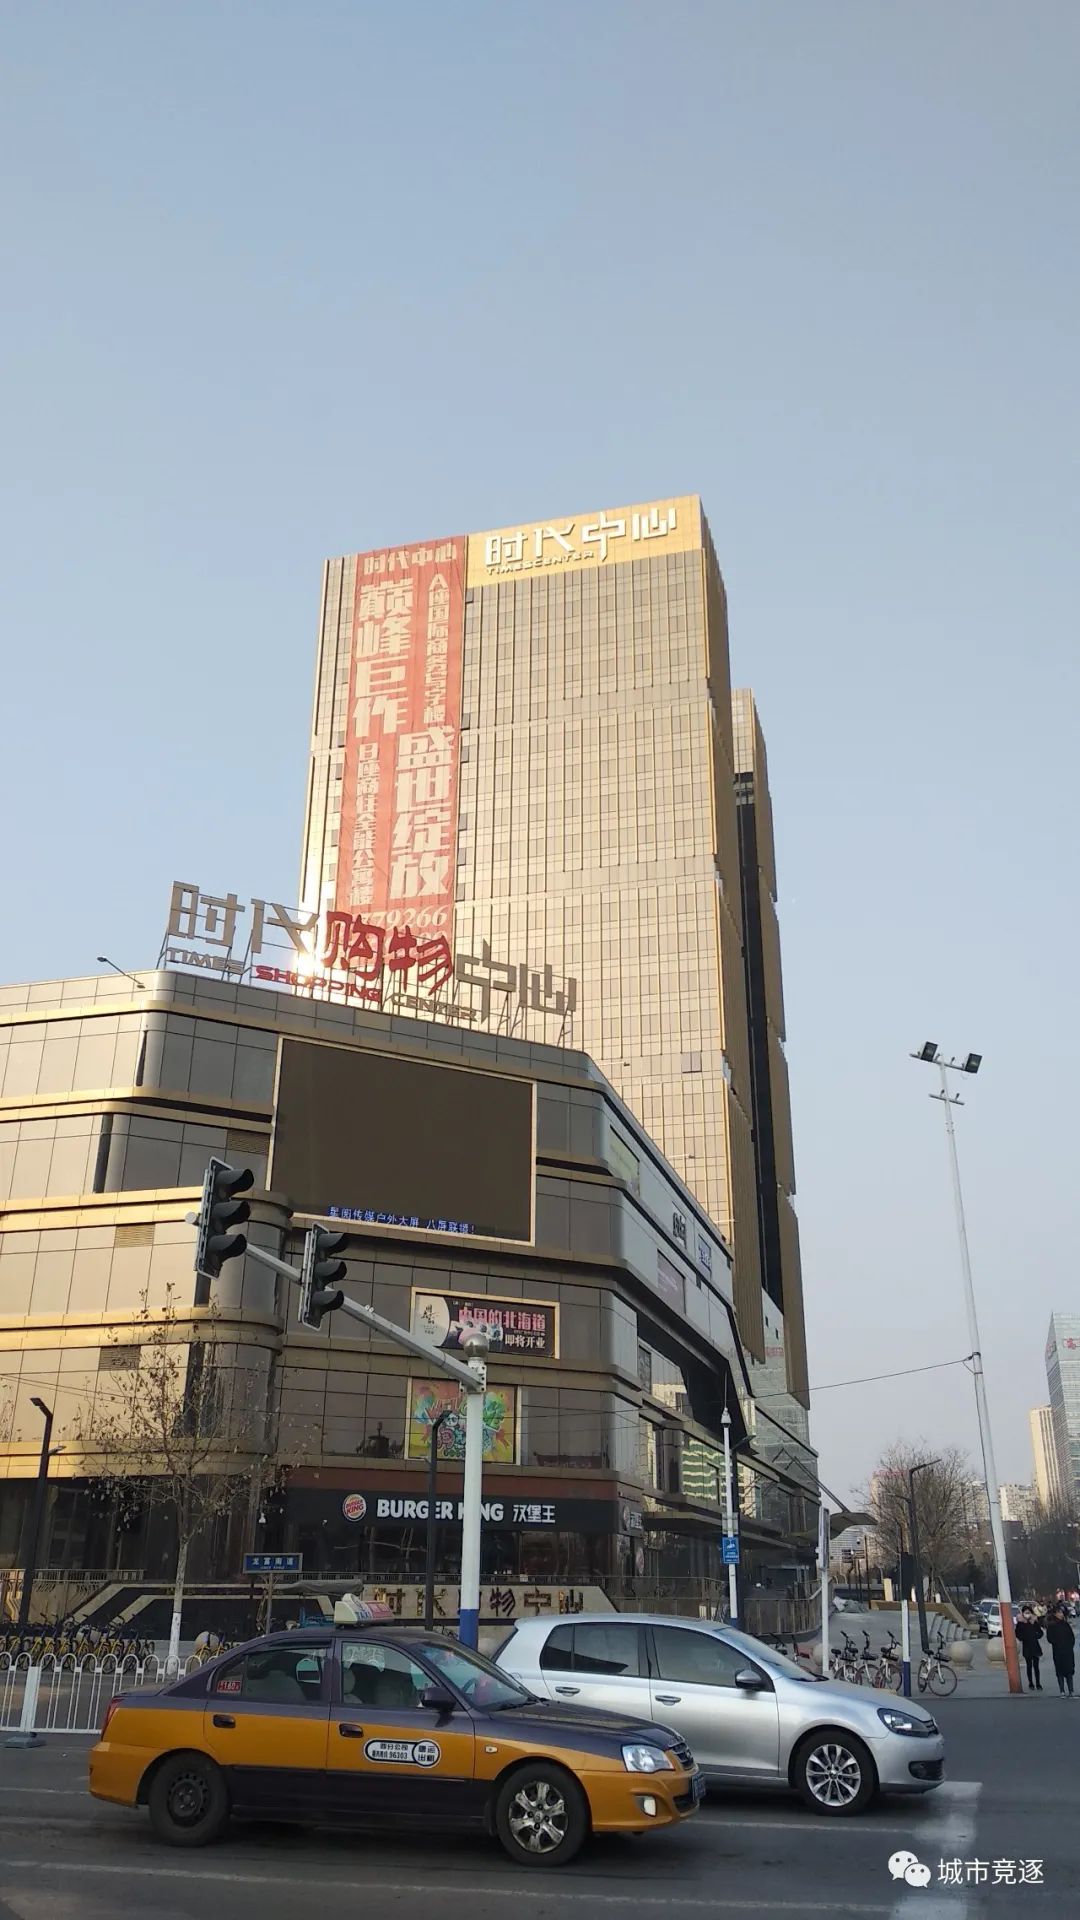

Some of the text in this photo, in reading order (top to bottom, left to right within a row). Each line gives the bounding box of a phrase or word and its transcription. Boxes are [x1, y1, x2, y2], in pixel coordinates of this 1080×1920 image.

[363, 542, 457, 576] 时代中心
[485, 508, 677, 566] 时代中心
[352, 577, 413, 738] 巅峰巨作
[390, 725, 455, 900] 盛世绽放
[168, 880, 577, 1025] 时代购物中心
[166, 946, 245, 976] TIMES
[391, 993, 478, 1023] CENTER
[504, 1334, 546, 1349] 即将开业
[512, 1504, 556, 1523] 汉堡王
[374, 1587, 584, 1617] 时代物中心
